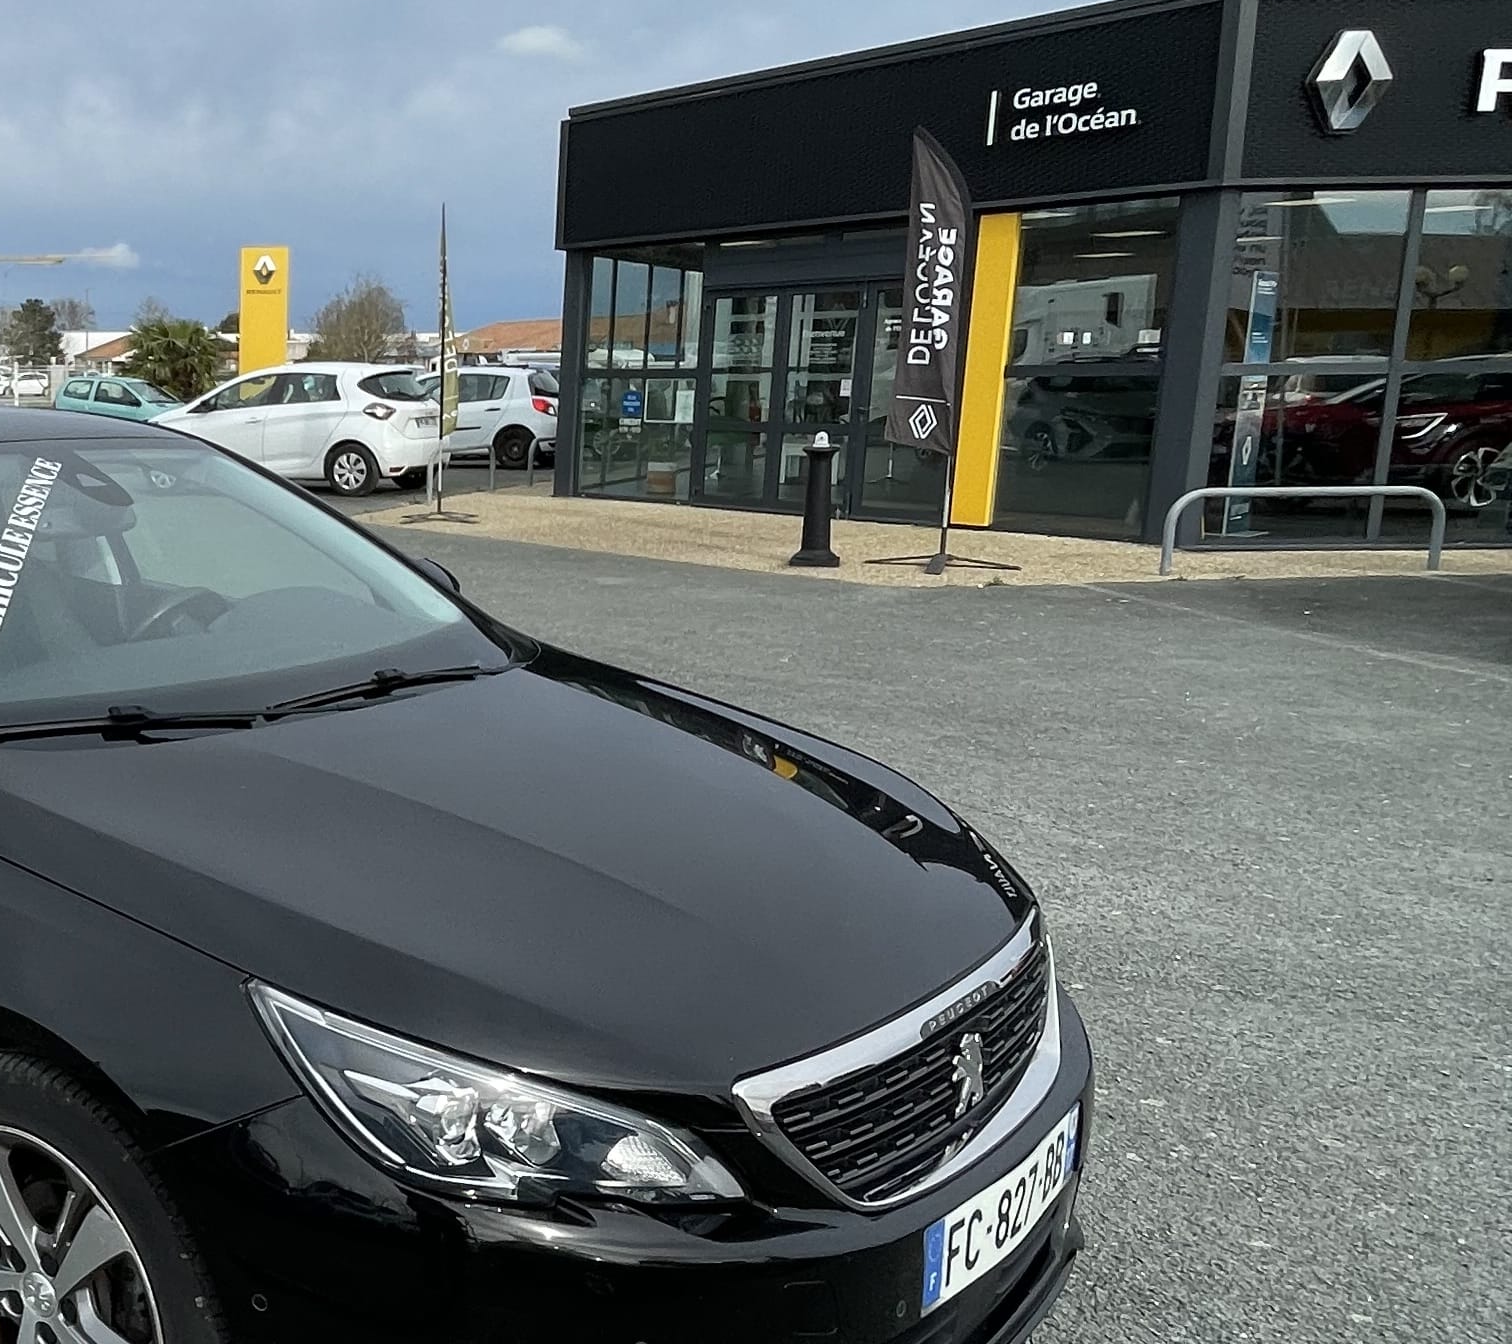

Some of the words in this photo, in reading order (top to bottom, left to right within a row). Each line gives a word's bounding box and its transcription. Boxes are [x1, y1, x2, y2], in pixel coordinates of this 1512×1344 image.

[1013, 81, 1098, 110] Garage
[1010, 118, 1040, 141] de
[1045, 107, 1138, 137] l'Océan
[7, 456, 63, 532] ESSENCE
[928, 987, 990, 1032] PEUGEOT
